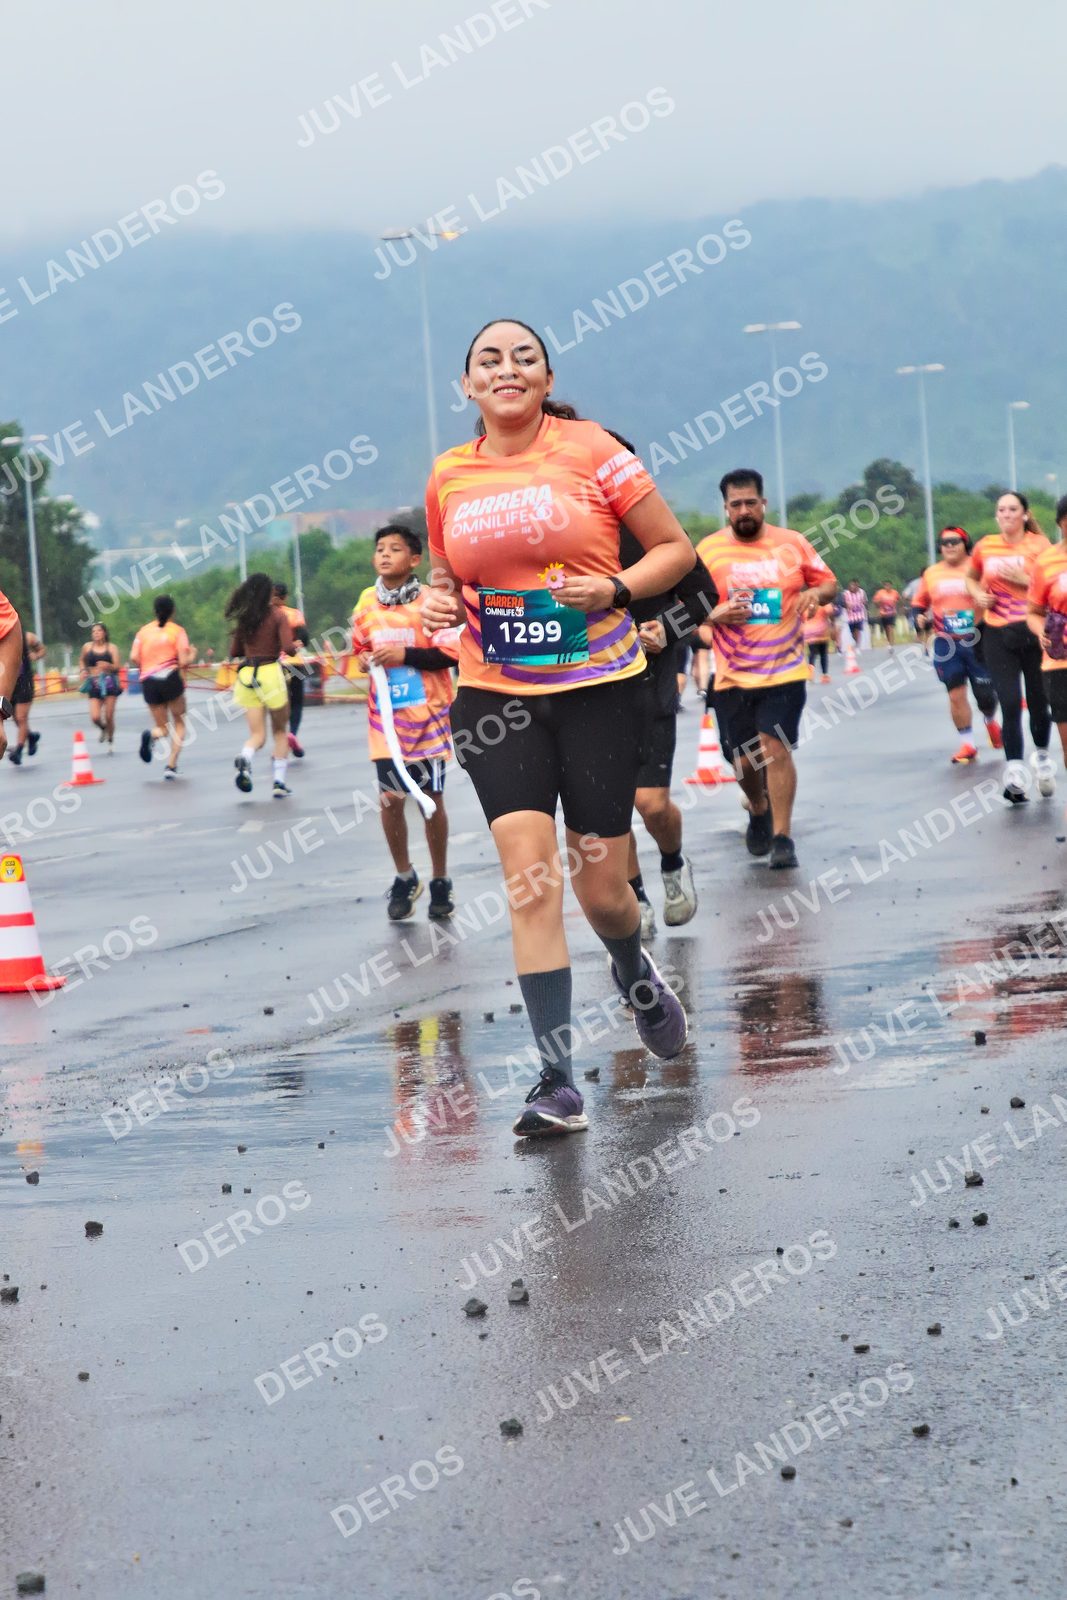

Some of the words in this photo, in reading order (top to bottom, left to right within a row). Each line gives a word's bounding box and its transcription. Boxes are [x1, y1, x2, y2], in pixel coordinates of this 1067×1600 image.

[454, 484, 552, 521] CARRERA
[451, 508, 528, 538] OMNILIFE
[485, 595, 524, 608] CARRERA
[485, 607, 515, 617] OMNILIFE
[499, 620, 562, 643] 1299
[390, 683, 409, 697] 57
